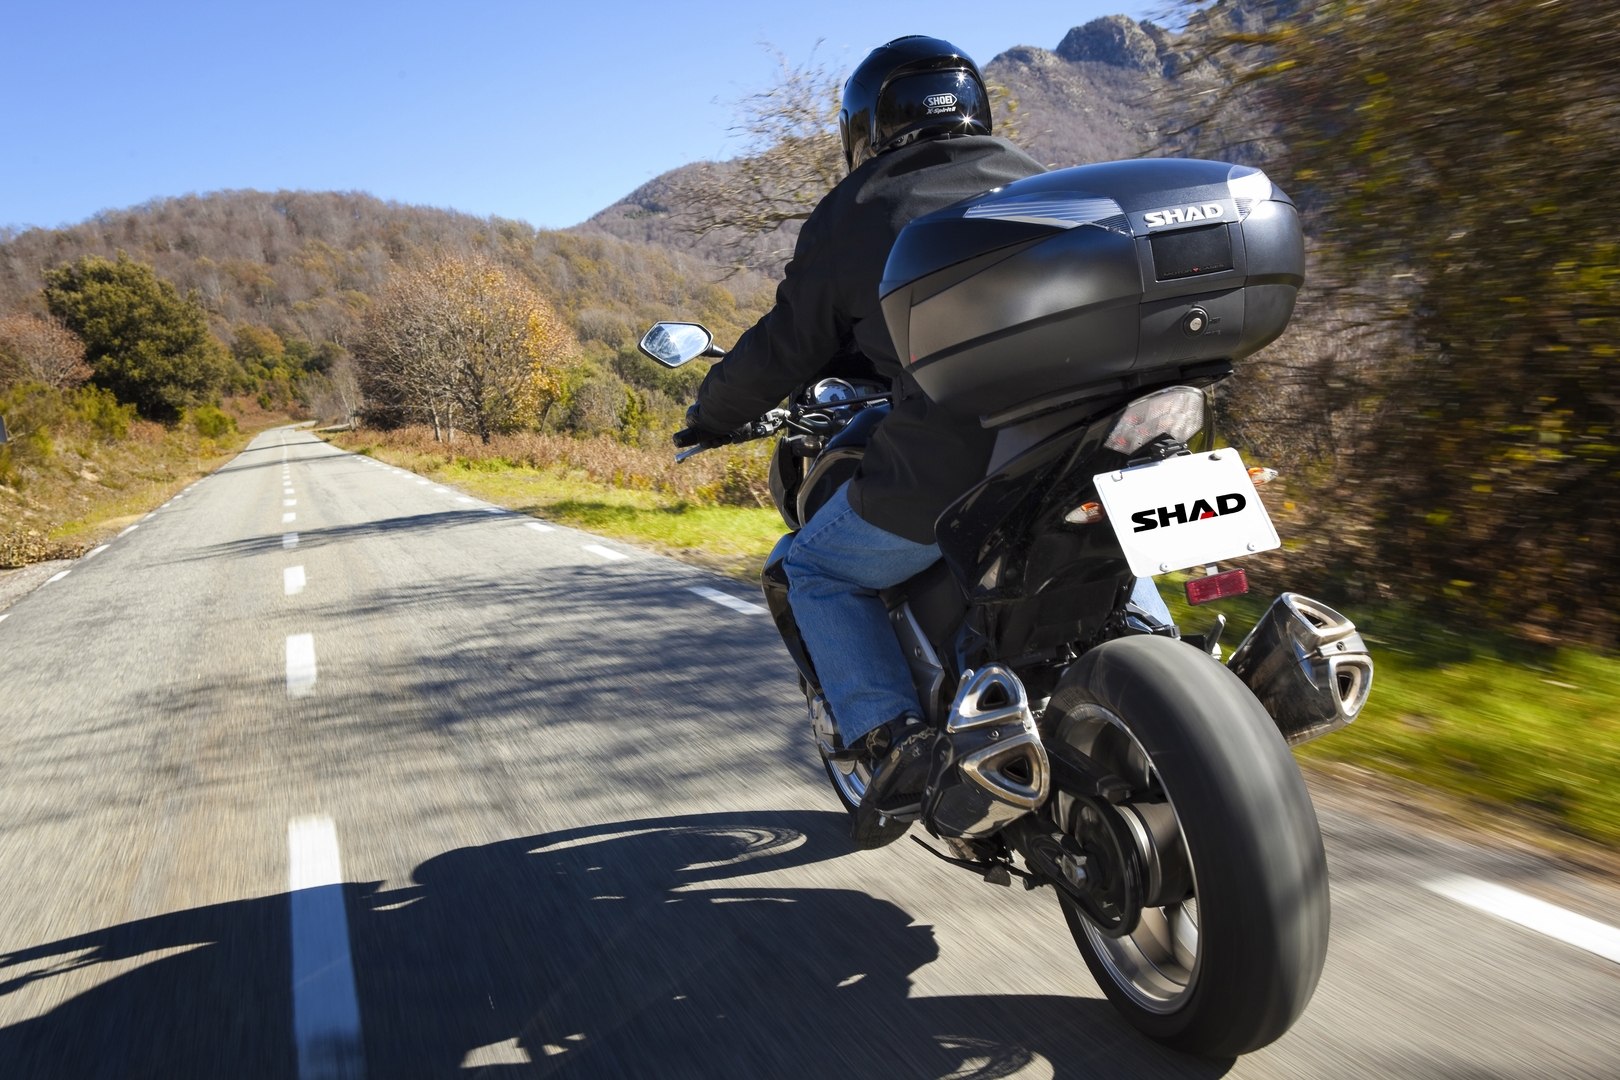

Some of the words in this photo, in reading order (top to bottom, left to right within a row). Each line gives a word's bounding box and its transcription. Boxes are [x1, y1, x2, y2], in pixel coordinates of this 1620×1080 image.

[928, 96, 953, 106] SHOEI
[1144, 203, 1224, 228] SHAD
[1163, 269, 1193, 277] MOTOR
[1199, 263, 1225, 271] CASES
[1131, 493, 1247, 533] SHAD
